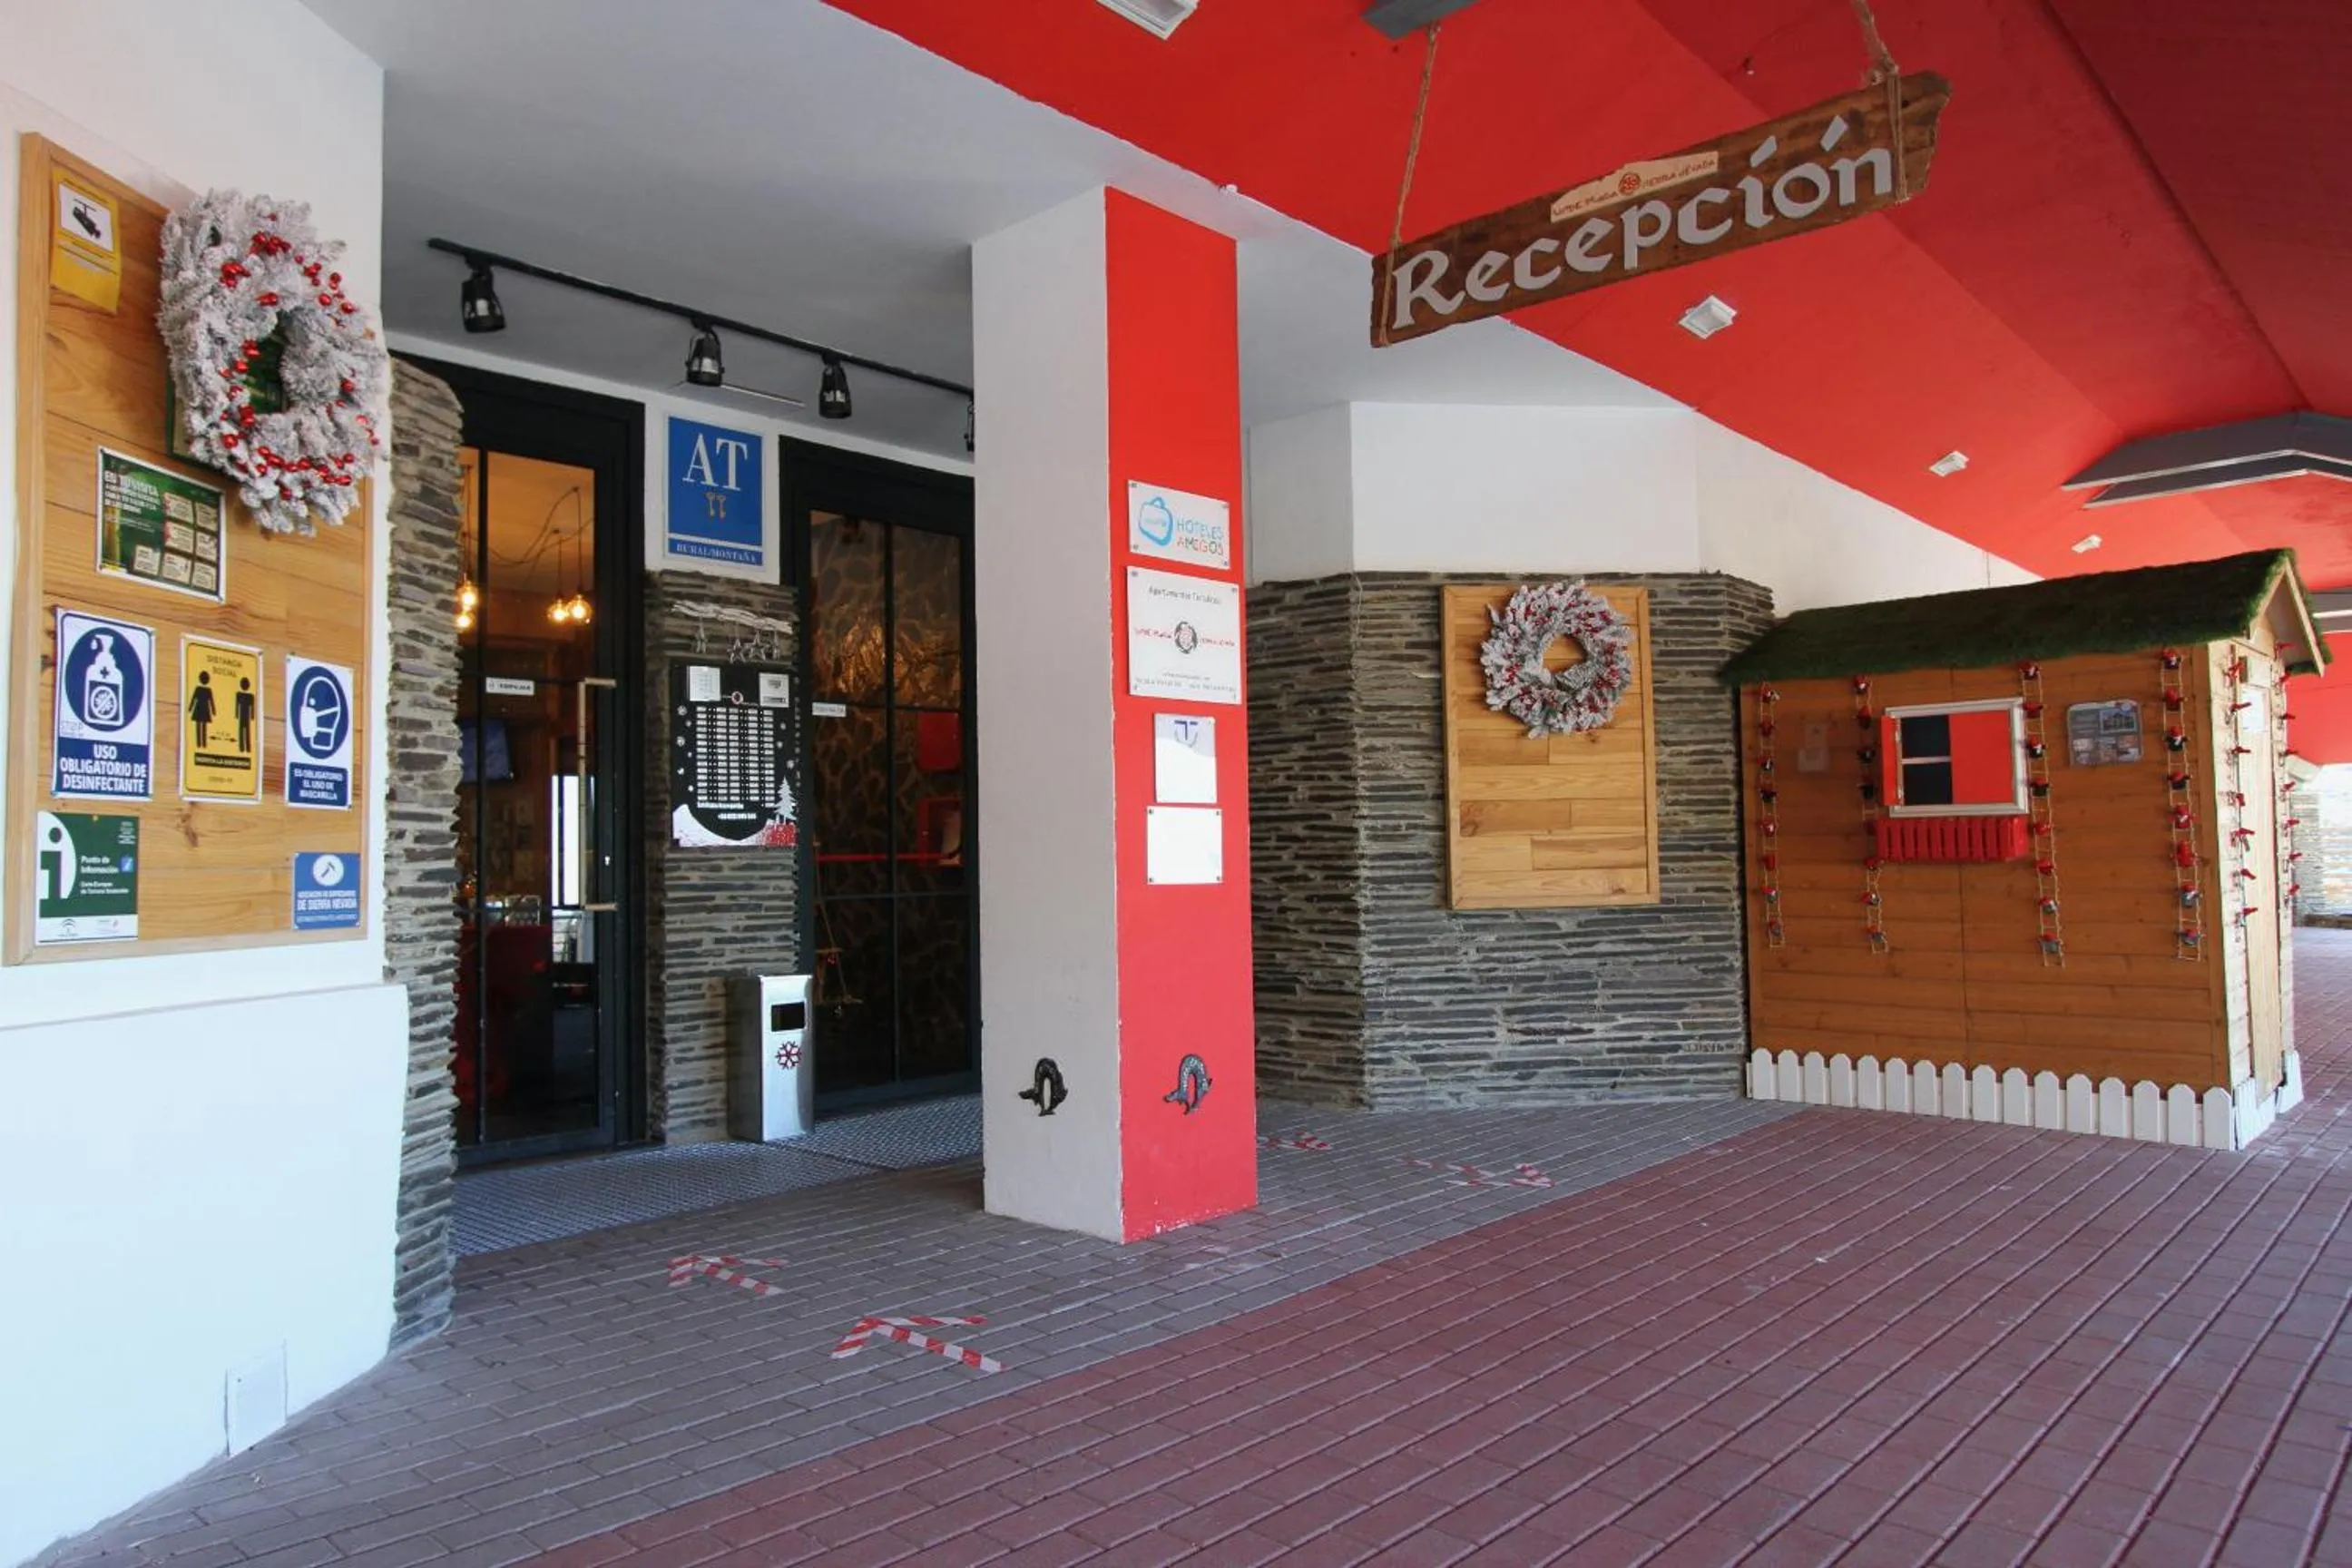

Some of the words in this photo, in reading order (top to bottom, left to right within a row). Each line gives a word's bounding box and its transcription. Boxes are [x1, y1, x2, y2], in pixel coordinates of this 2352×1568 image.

[1391, 115, 1893, 329] Recepción
[682, 432, 748, 492] AT
[1177, 517, 1223, 541] HOTELES
[93, 743, 118, 760] USO
[60, 757, 132, 778] OBLIGATORIO
[133, 764, 147, 779] DE
[62, 773, 145, 793] DESINFECTANTE
